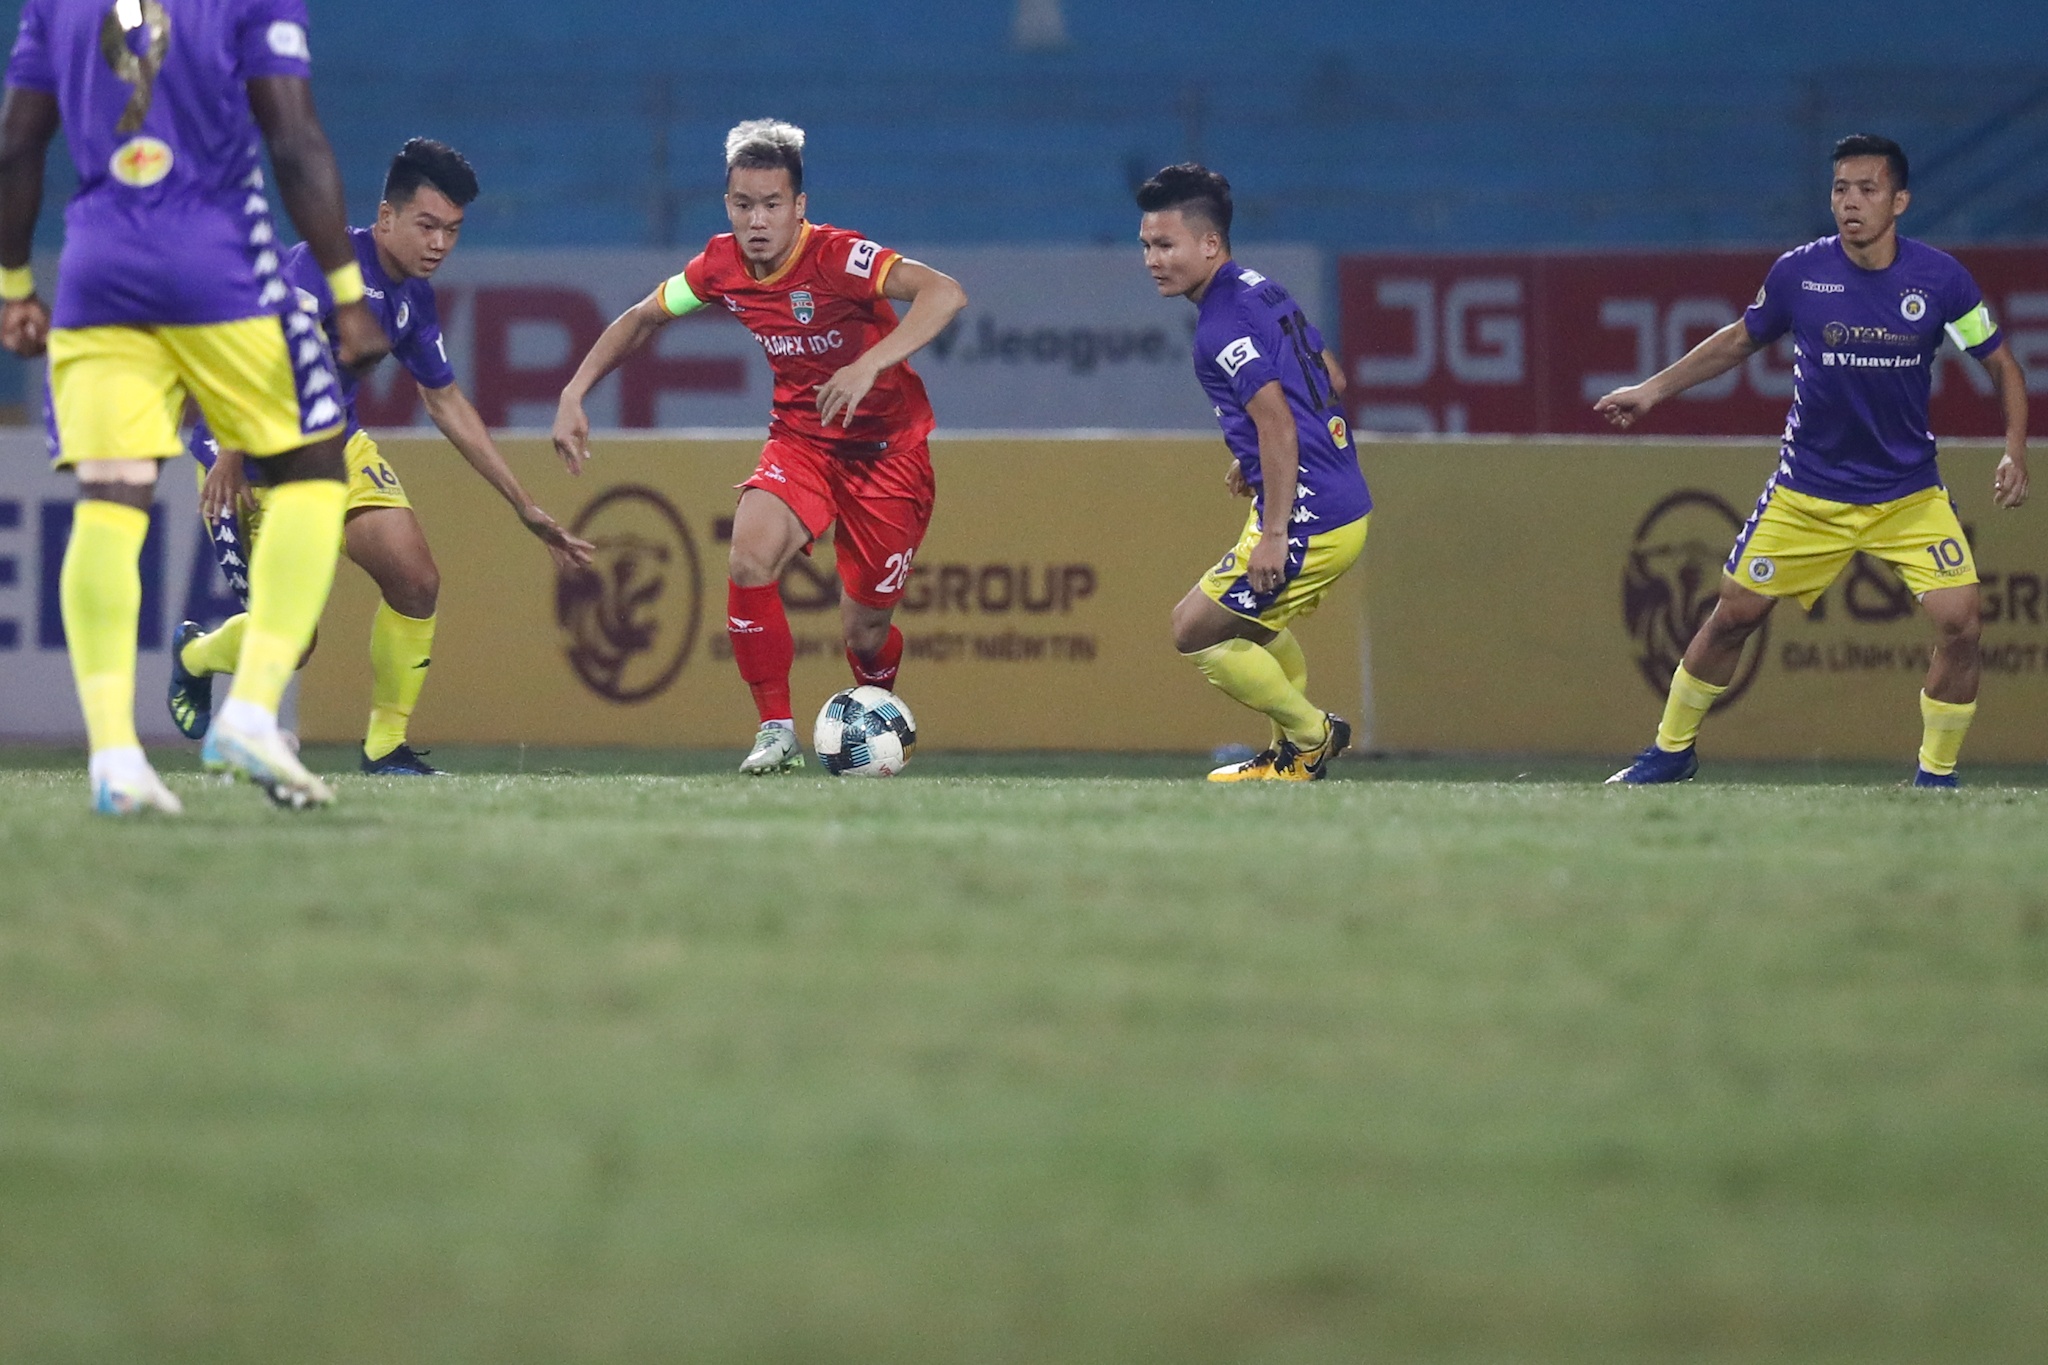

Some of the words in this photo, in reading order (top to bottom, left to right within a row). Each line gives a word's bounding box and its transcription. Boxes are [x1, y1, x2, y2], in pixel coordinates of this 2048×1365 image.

[854, 243, 875, 271] LS
[1802, 280, 1845, 293] Kappa
[808, 330, 843, 355] IDC
[1224, 342, 1247, 370] LS
[1837, 353, 1921, 368] Vinawind
[361, 463, 396, 488] 16
[1926, 538, 1964, 570] 10
